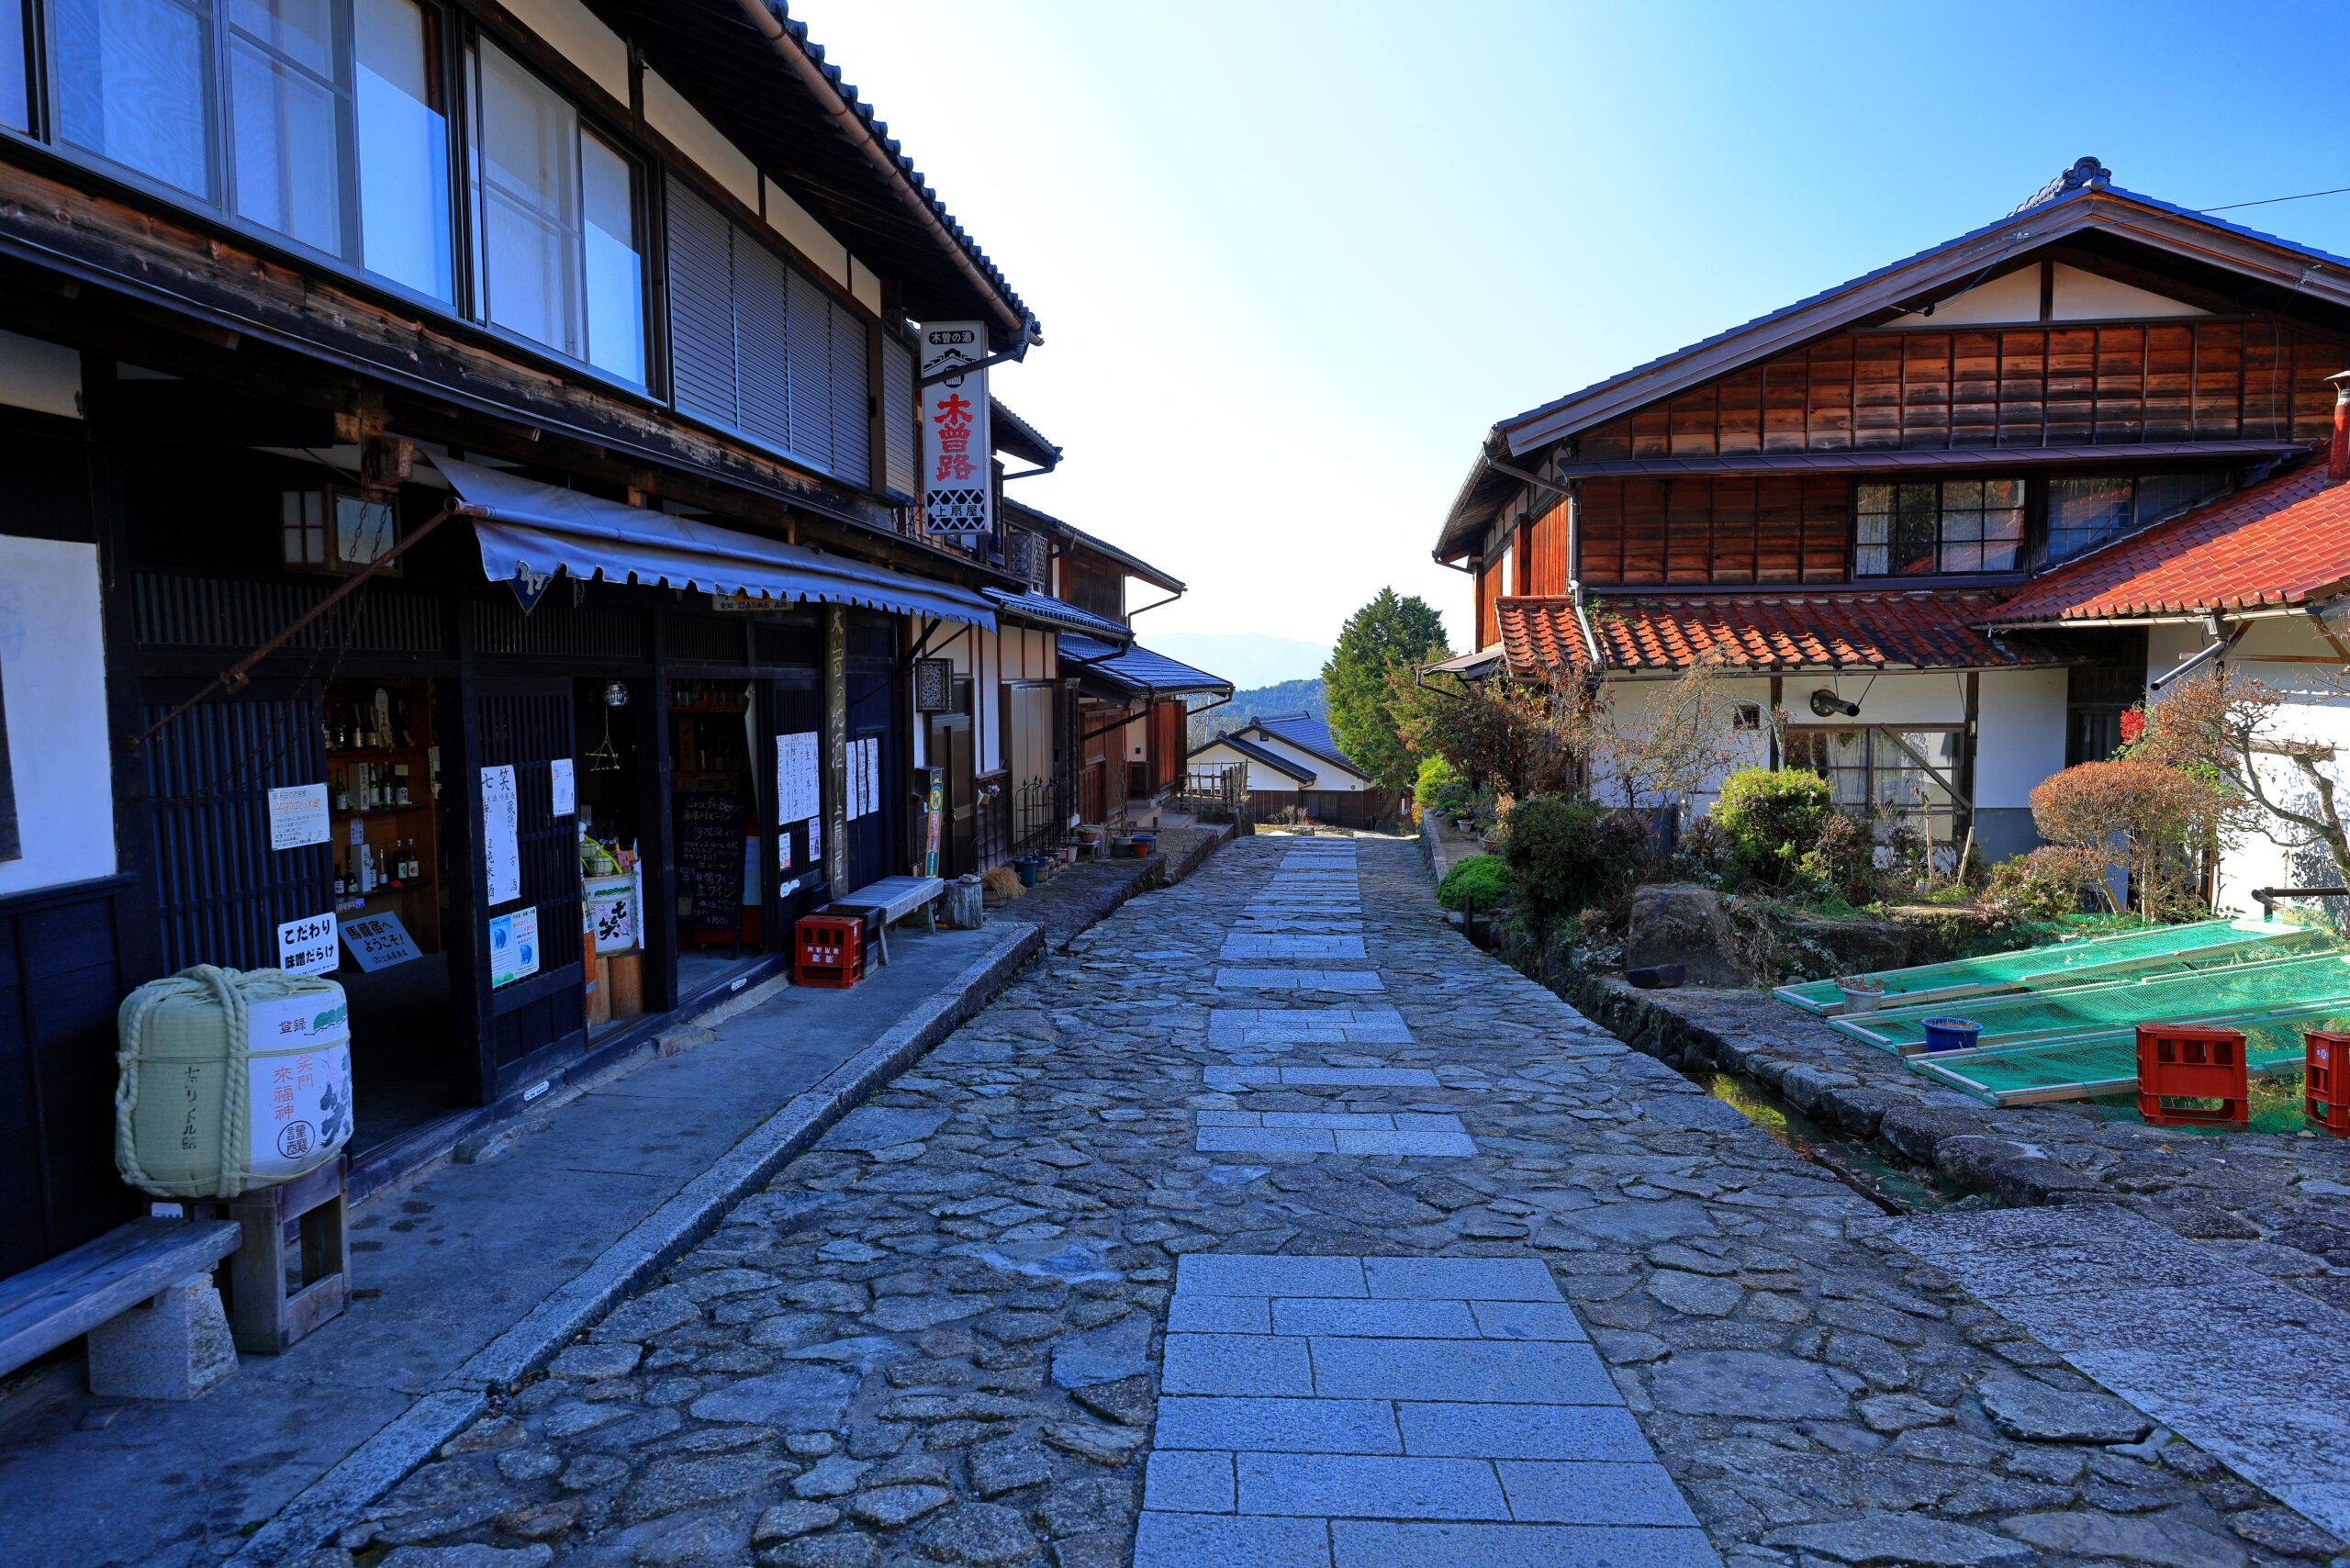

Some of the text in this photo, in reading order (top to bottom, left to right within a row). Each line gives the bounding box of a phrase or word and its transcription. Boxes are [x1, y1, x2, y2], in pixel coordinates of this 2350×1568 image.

[931, 330, 972, 343] 木曽の酒
[931, 393, 979, 482] 木曽路
[935, 504, 979, 518] 上扇屋
[481, 768, 510, 791] 七笑
[285, 919, 331, 945] こだわり
[344, 920, 394, 941] 馬籠宿へ
[285, 944, 334, 970] 味噌だらけ
[279, 1017, 307, 1035] 登録
[295, 1053, 314, 1092] 笑門
